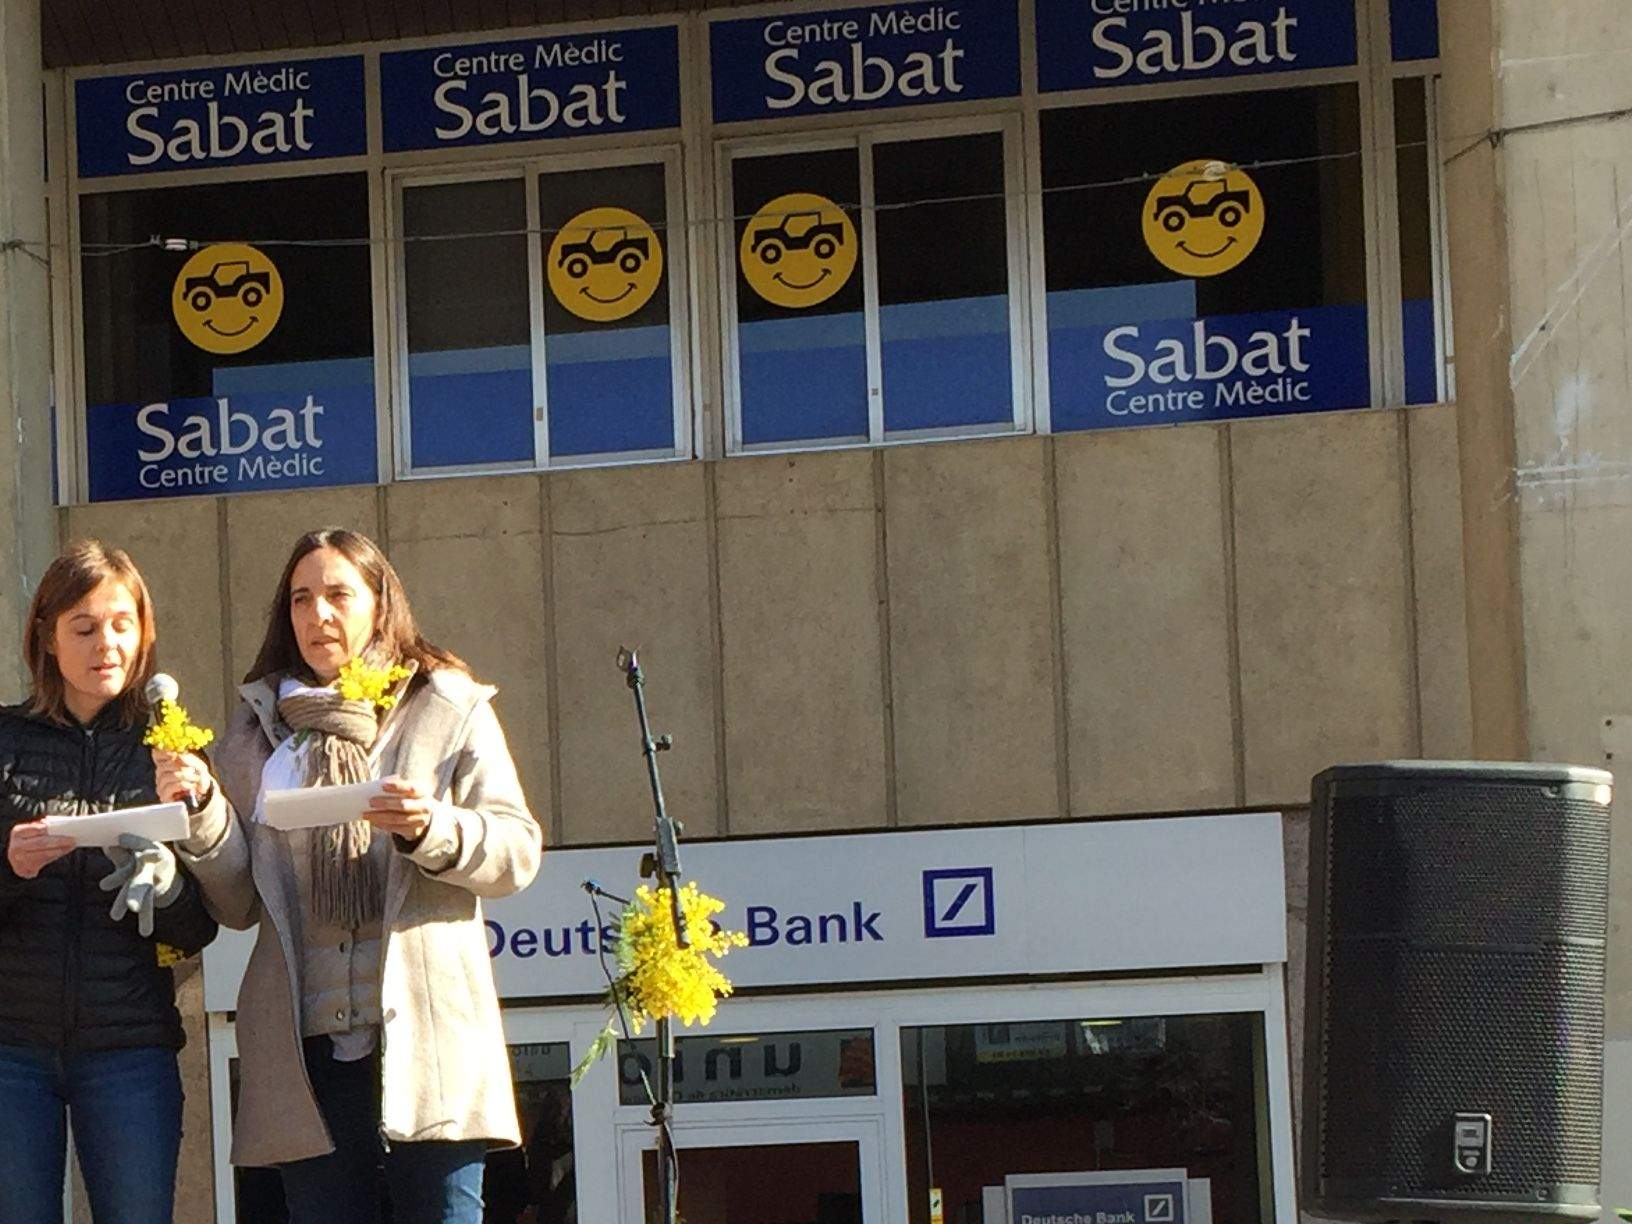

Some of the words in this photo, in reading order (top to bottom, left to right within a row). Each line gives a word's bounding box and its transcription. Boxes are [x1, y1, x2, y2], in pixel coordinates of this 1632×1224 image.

[764, 20, 858, 46] Centre
[869, 7, 961, 37] Mèdic
[1091, 6, 1298, 79] Sabat
[433, 52, 525, 78] Centre
[535, 40, 624, 69] Mèdic
[764, 37, 965, 109] Sabat
[126, 79, 215, 105] Centre
[224, 68, 311, 97] Mèdic
[433, 69, 627, 140] Sabat
[126, 97, 314, 165] Sabat
[1102, 316, 1311, 388] Sabat
[1105, 389, 1204, 416] Centre
[1214, 378, 1311, 407] Mèdic
[136, 395, 324, 462] Sabat
[139, 464, 229, 488] Centre
[237, 453, 325, 481] Mèdic
[747, 901, 884, 948] Bank
[1096, 1211, 1136, 1224] Bank
